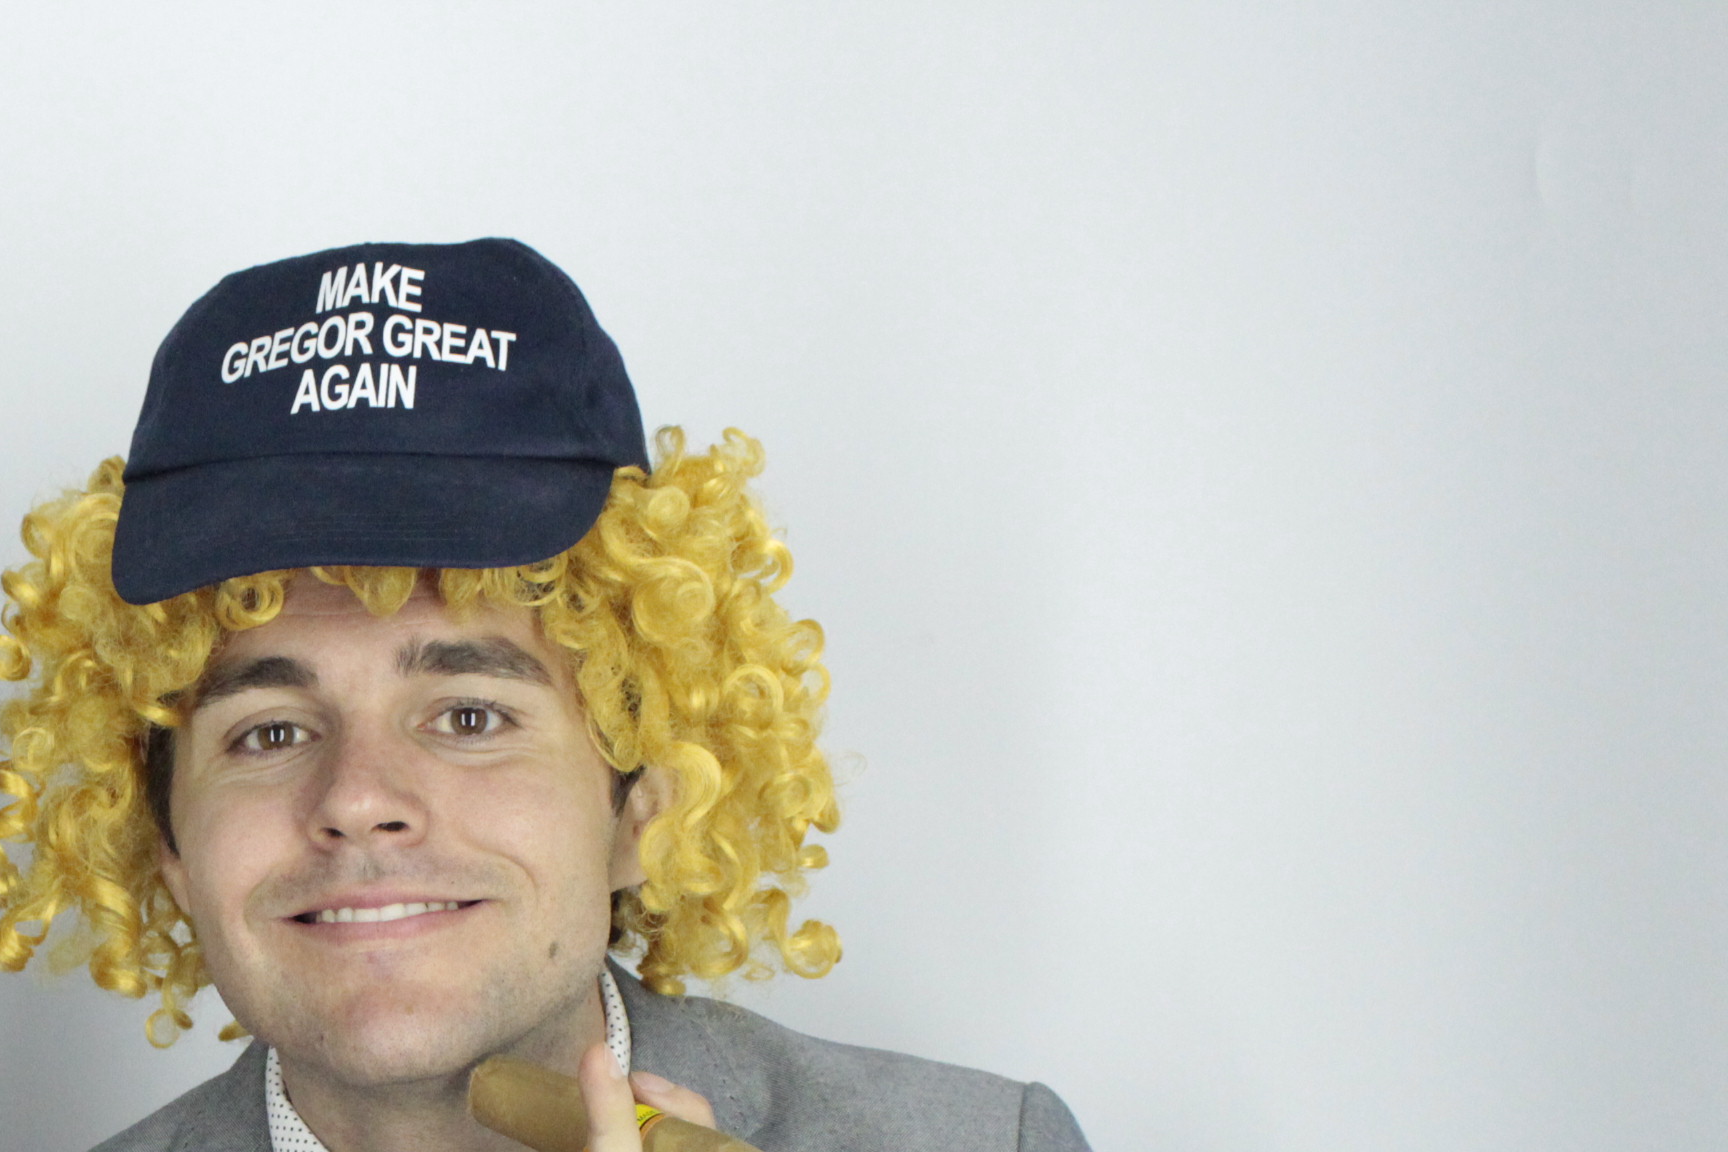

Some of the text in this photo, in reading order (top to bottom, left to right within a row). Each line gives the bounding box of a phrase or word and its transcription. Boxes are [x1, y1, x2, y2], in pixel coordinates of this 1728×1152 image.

[315, 261, 426, 314] MAKE
[220, 311, 517, 384] GREGOR GREAT
[290, 362, 417, 415] AGAIN
